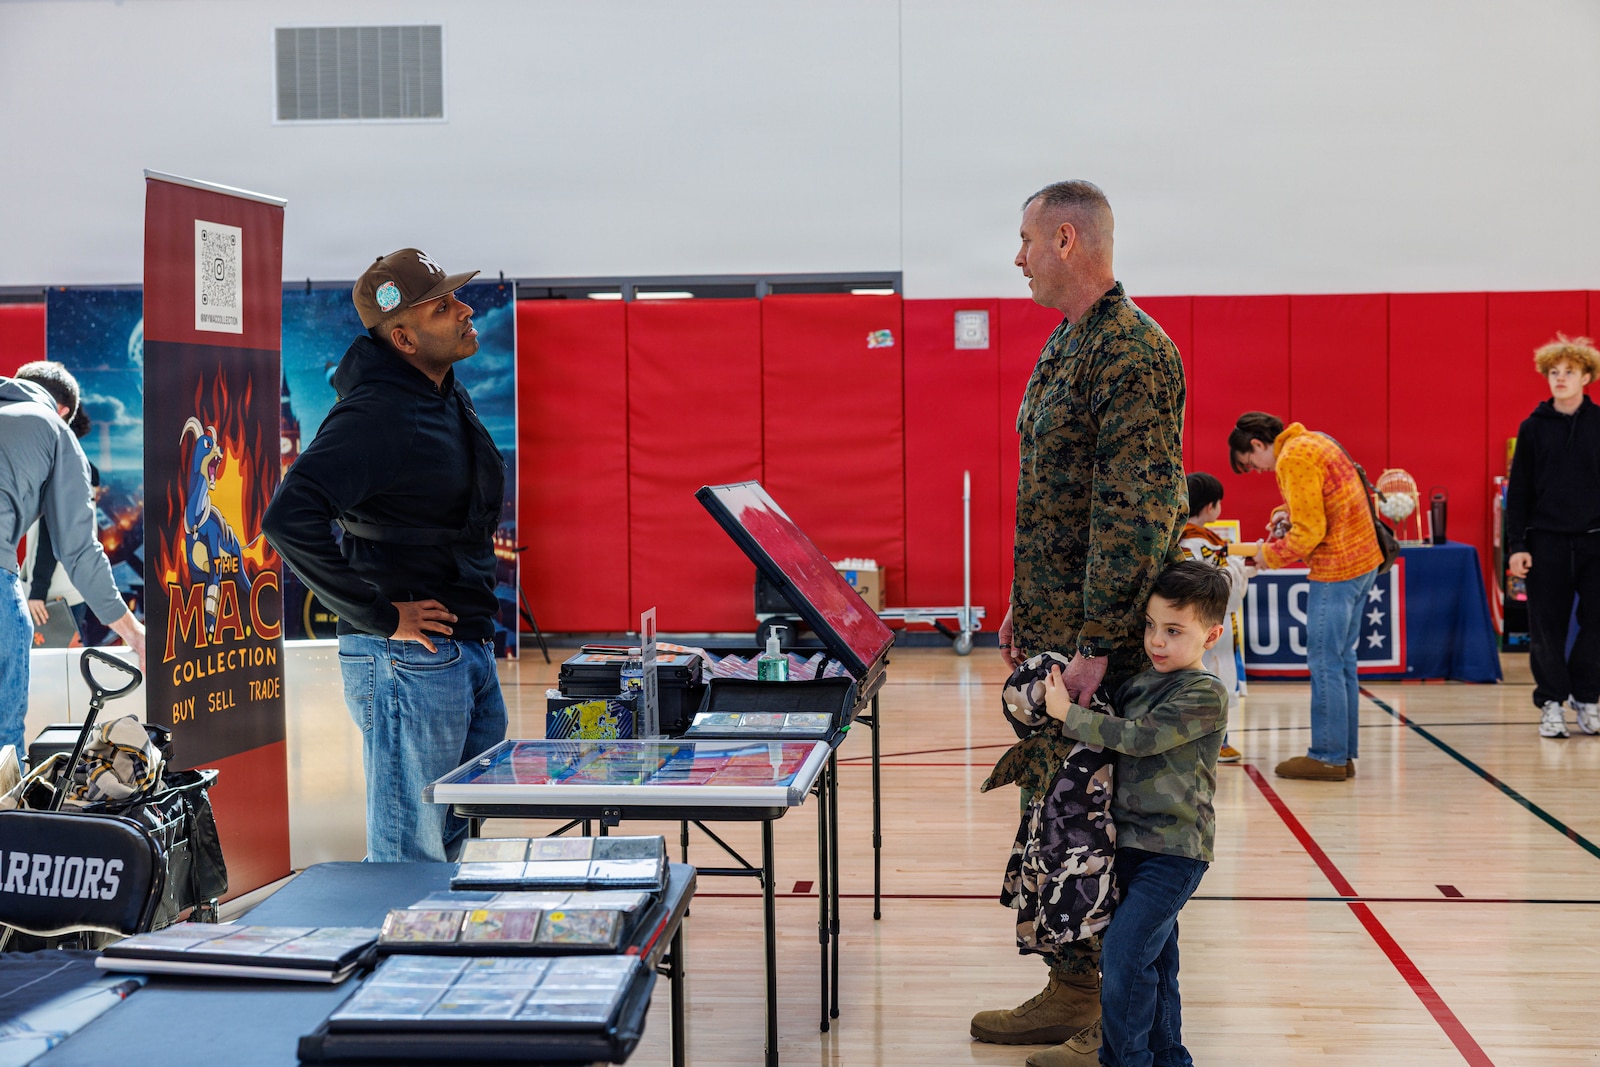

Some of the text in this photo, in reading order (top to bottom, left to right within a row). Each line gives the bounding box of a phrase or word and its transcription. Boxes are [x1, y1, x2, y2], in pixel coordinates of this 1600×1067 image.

[213, 557, 239, 574] THE
[173, 646, 277, 687] COLLECTION
[172, 677, 281, 725] BUY SELL TRADE
[0, 850, 125, 900] RRIORS
